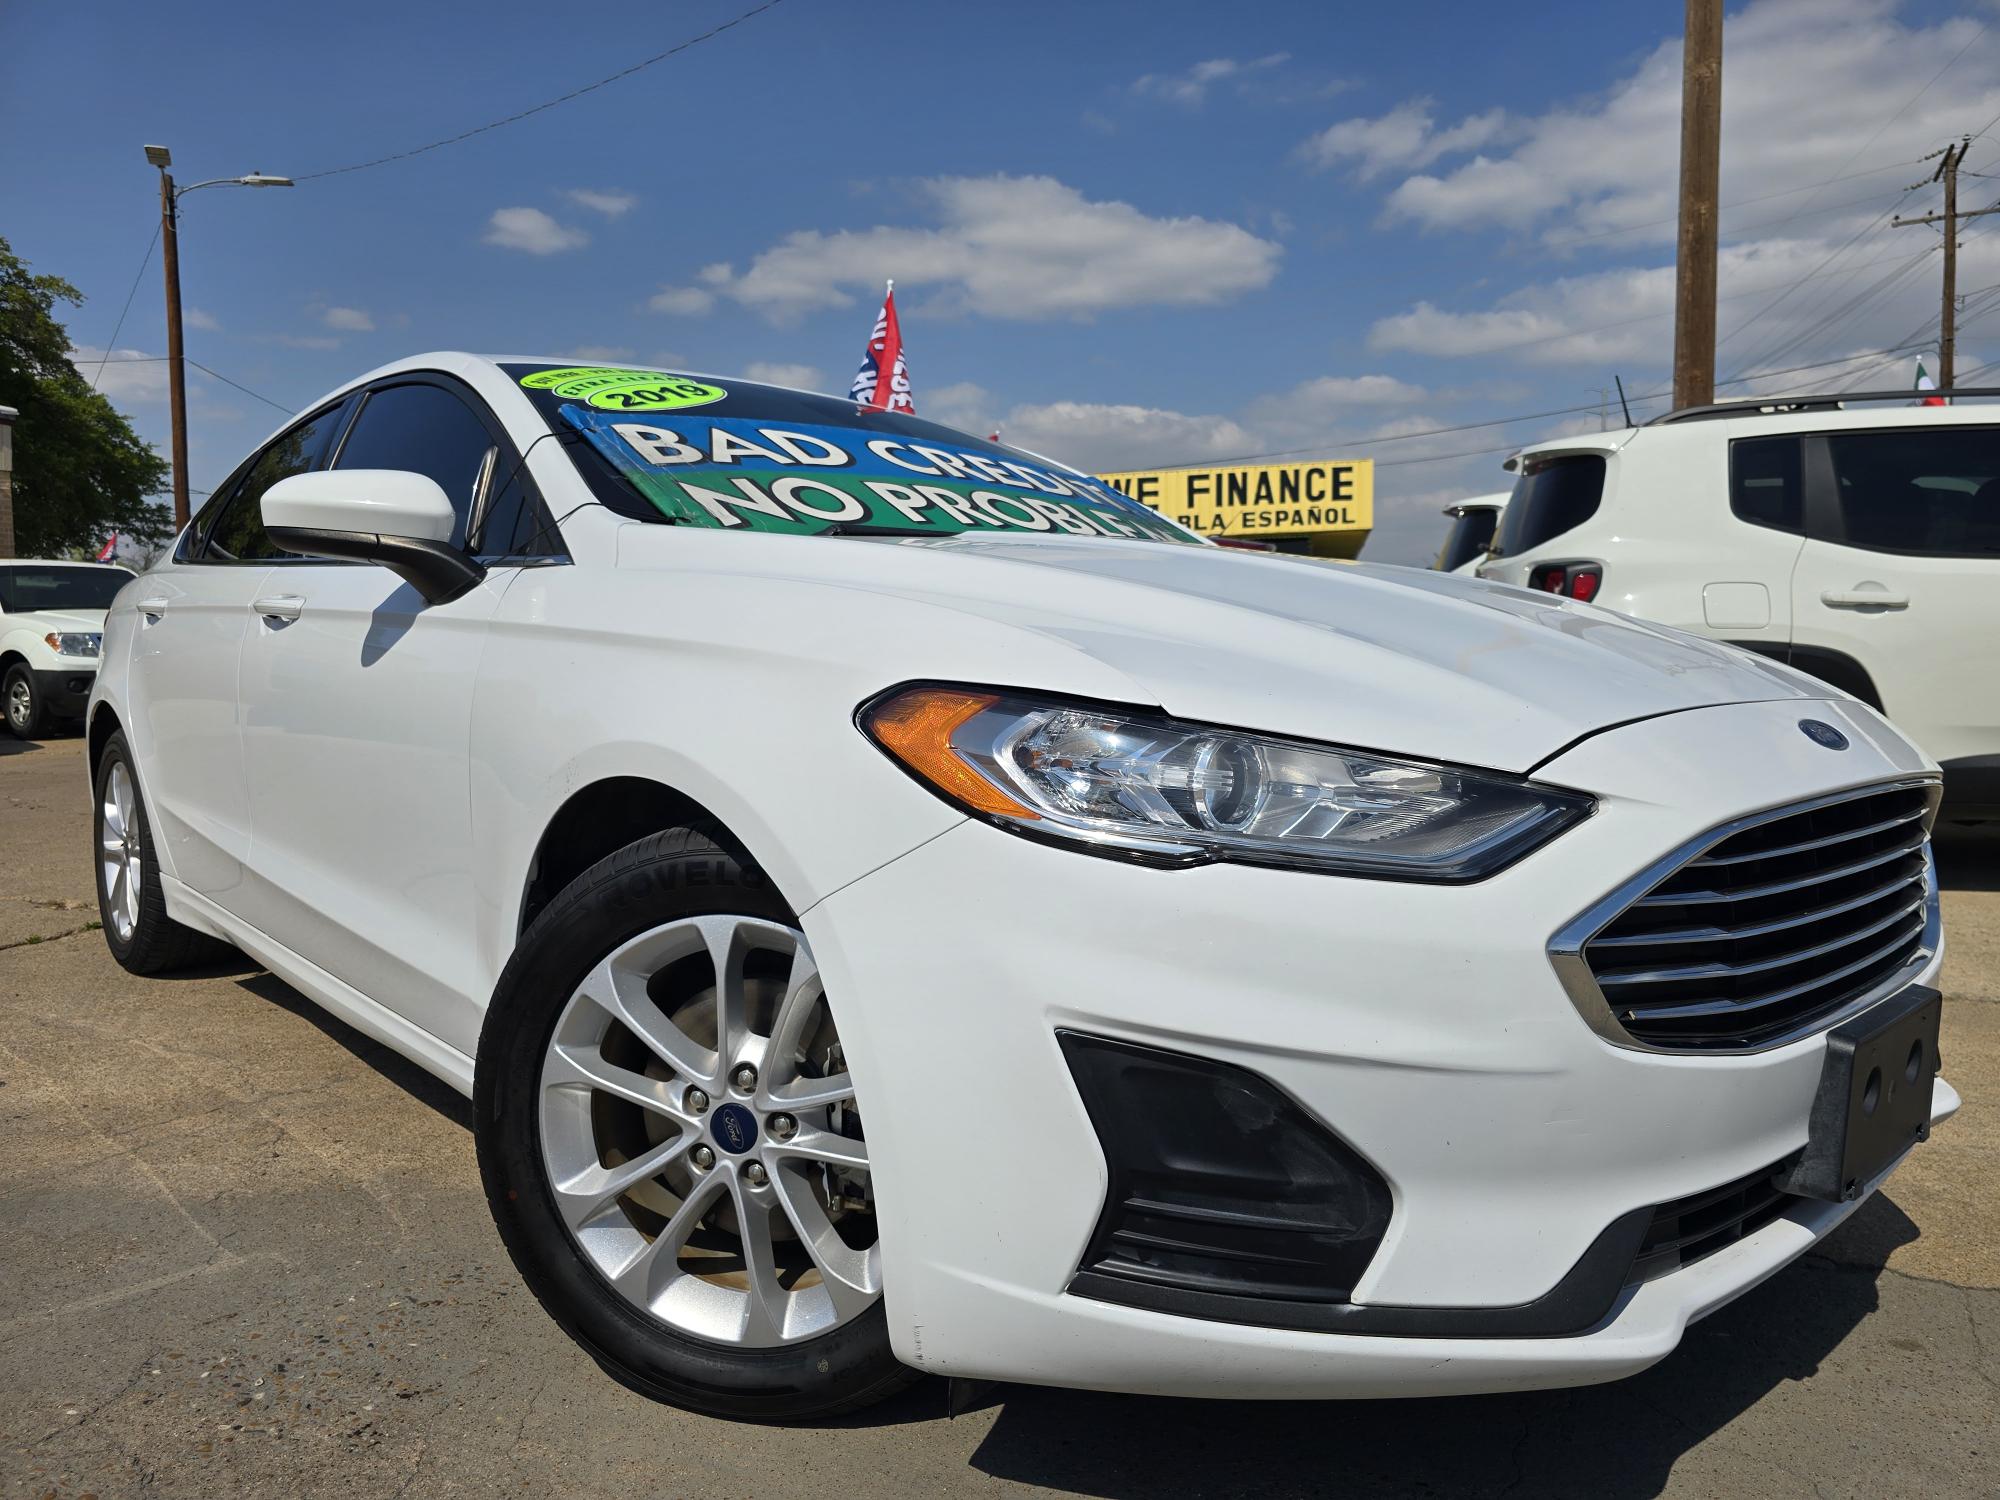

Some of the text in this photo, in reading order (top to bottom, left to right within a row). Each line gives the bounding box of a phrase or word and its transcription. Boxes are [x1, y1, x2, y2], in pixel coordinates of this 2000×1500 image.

[563, 377, 614, 396] EXTRA
[605, 384, 711, 408] 2019
[610, 423, 849, 467] BAD
[677, 477, 866, 527] NO
[1187, 466, 1354, 510] FINANCE
[1177, 505, 1356, 532] BLA ESPAÑOL
[597, 859, 766, 908] ROVELO
